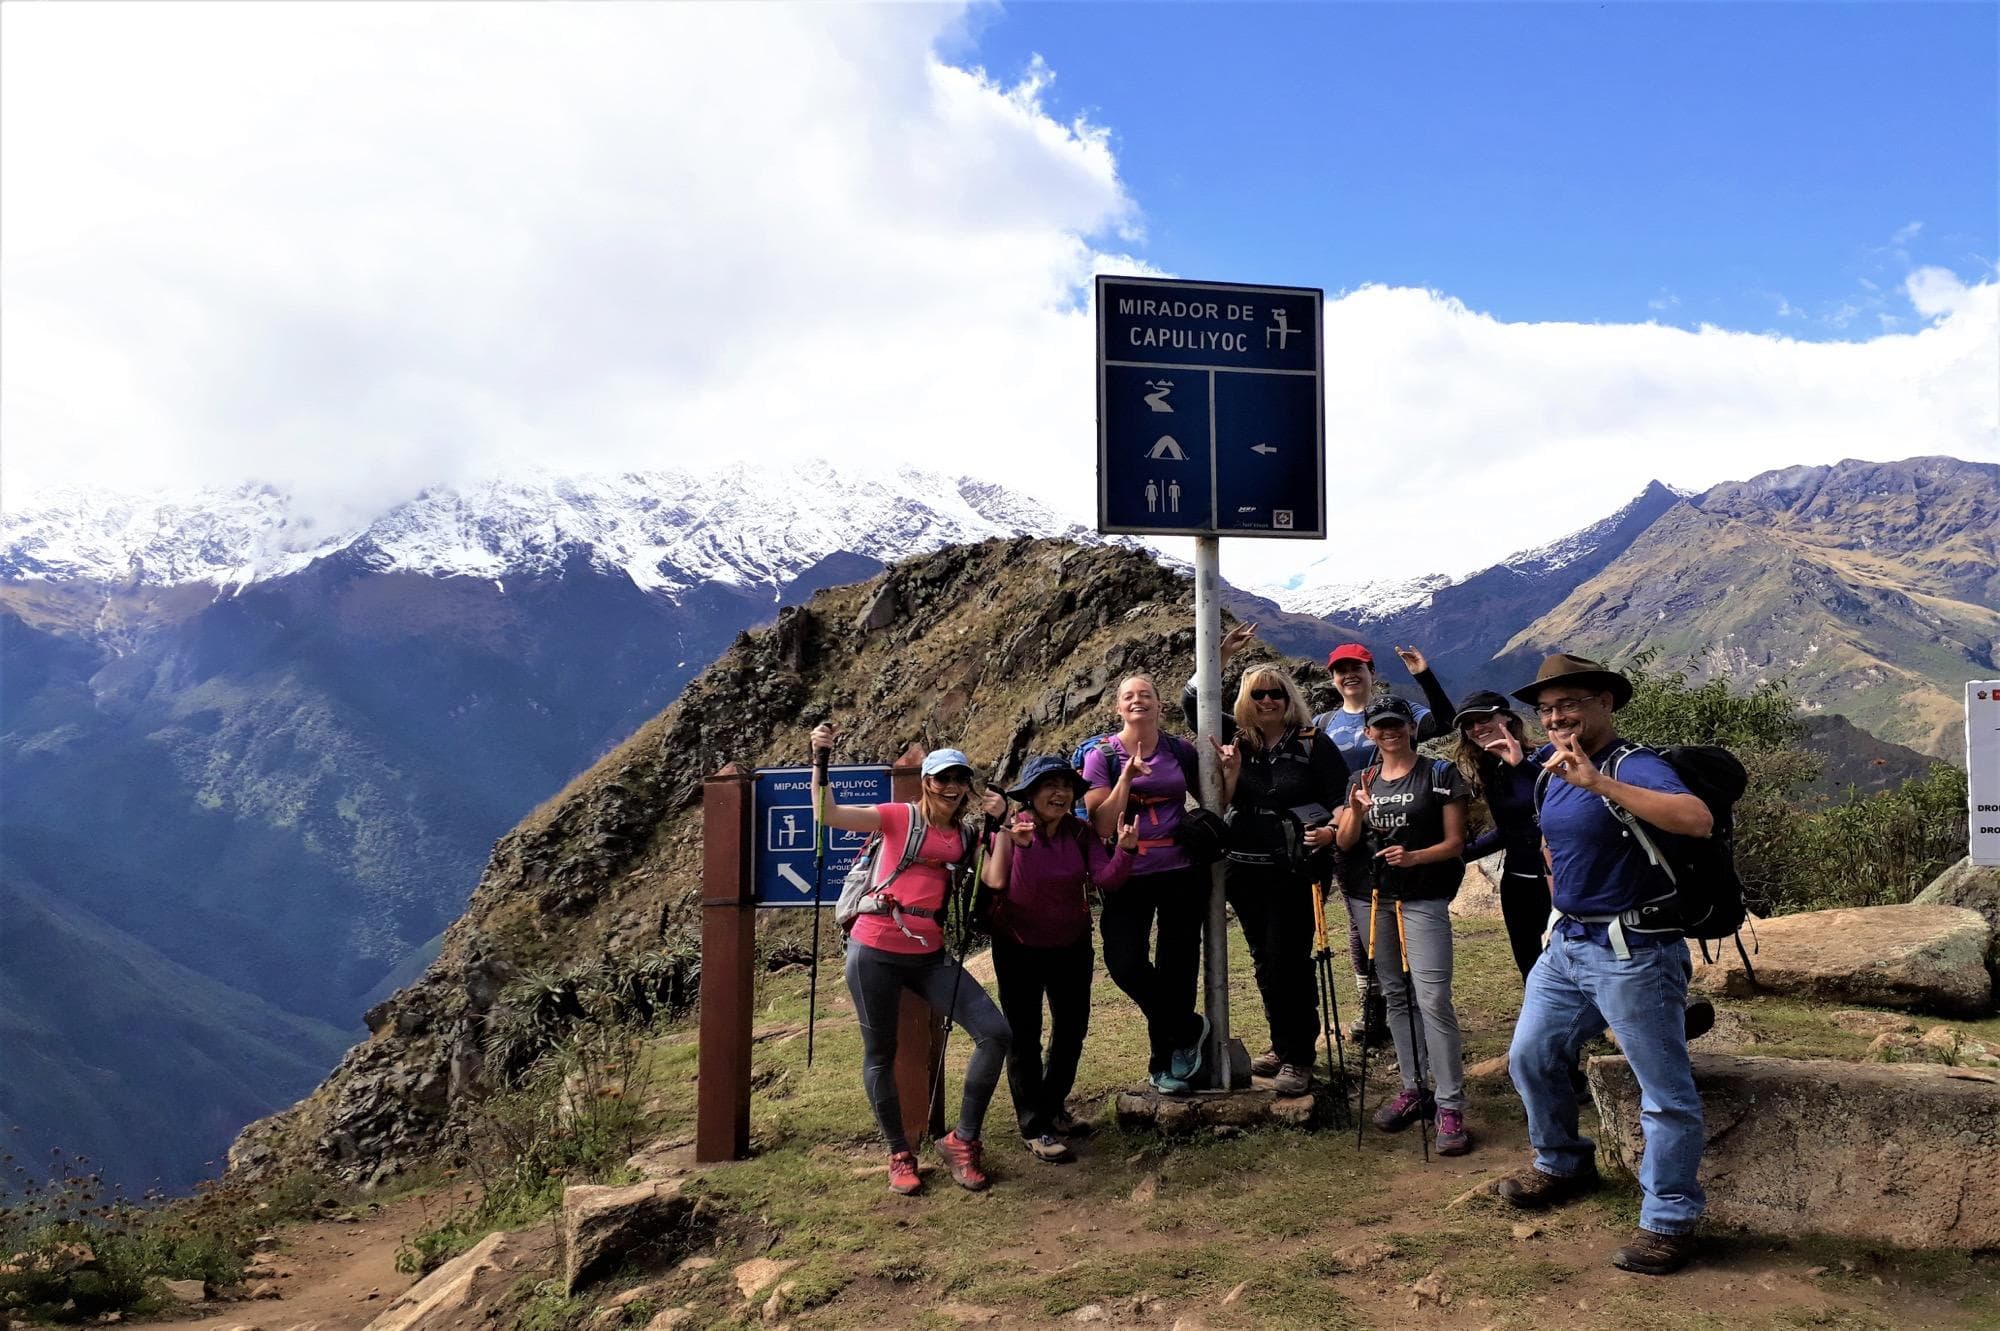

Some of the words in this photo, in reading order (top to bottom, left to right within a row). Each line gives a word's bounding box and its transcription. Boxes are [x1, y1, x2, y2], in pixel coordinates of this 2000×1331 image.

[1119, 298, 1219, 320] MIRADOR
[1227, 304, 1254, 321] DE
[1130, 326, 1247, 352] CAPULIYOC
[830, 780, 878, 789] APULIYOC
[1371, 793, 1414, 806] keep
[1977, 804, 2000, 812] DRO
